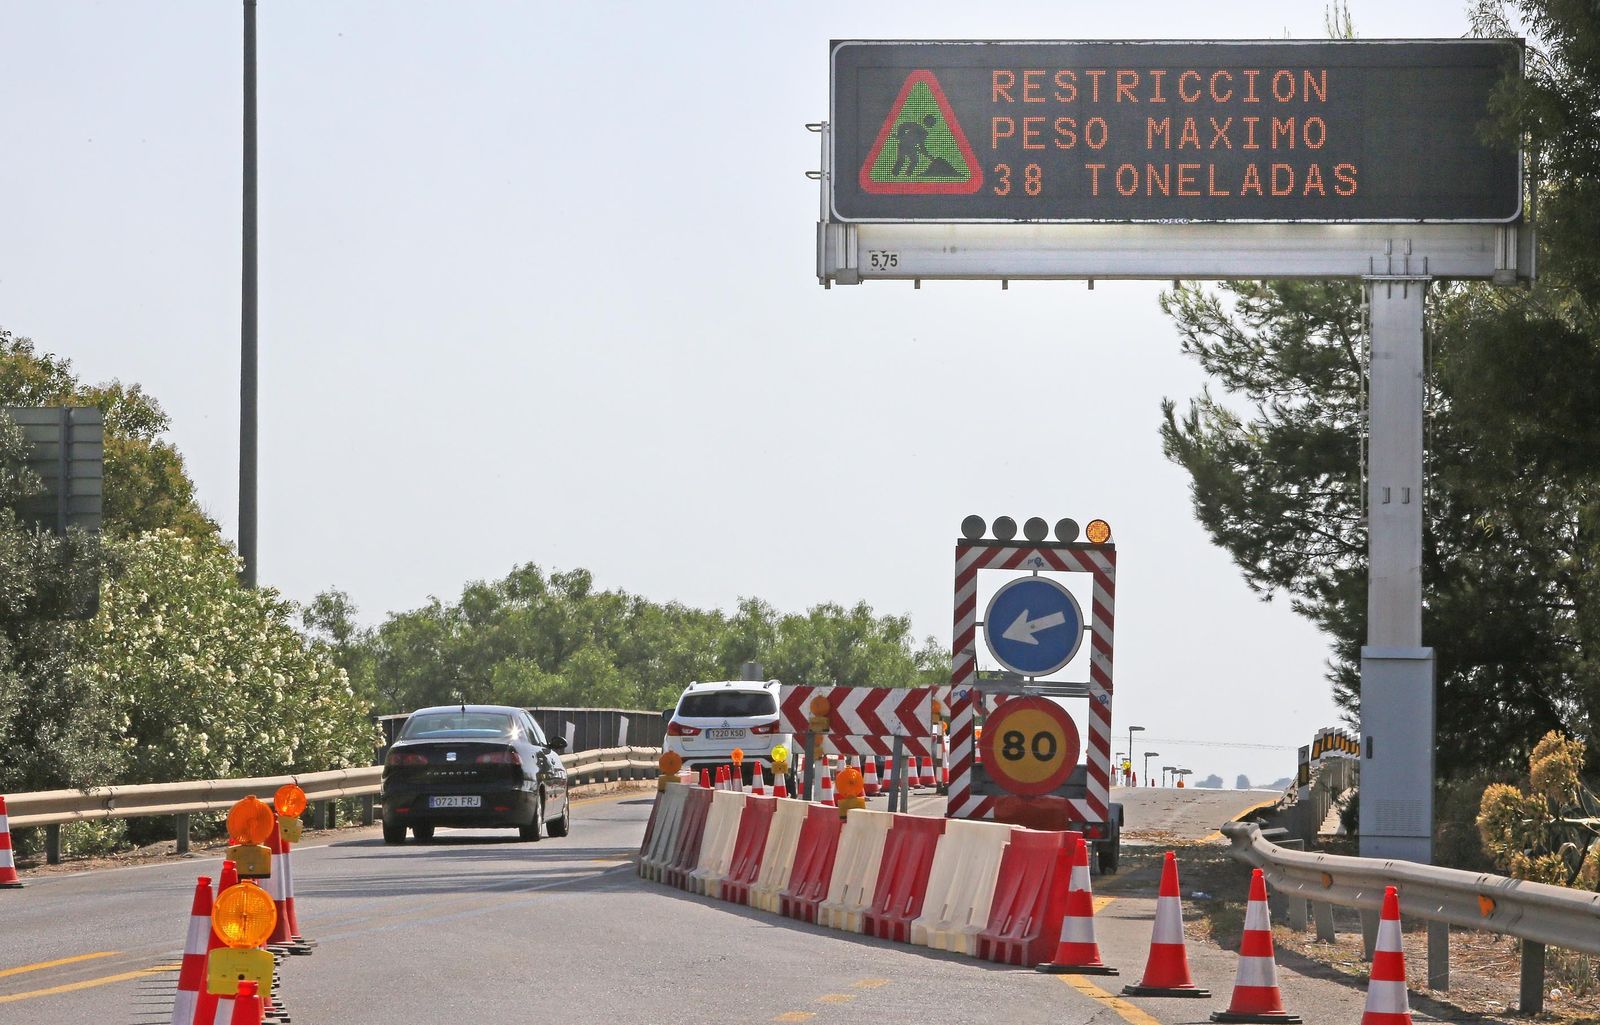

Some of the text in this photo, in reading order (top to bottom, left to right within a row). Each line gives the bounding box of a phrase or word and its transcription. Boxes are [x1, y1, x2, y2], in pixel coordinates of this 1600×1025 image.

[993, 70, 1328, 104] RESTRICCION
[992, 117, 1327, 150] PESO MAXIMO
[993, 163, 1358, 197] 38 TONELADAS
[871, 254, 898, 268] 5,75
[1002, 730, 1057, 762] 80
[435, 797, 479, 806] 0721 FRJ
